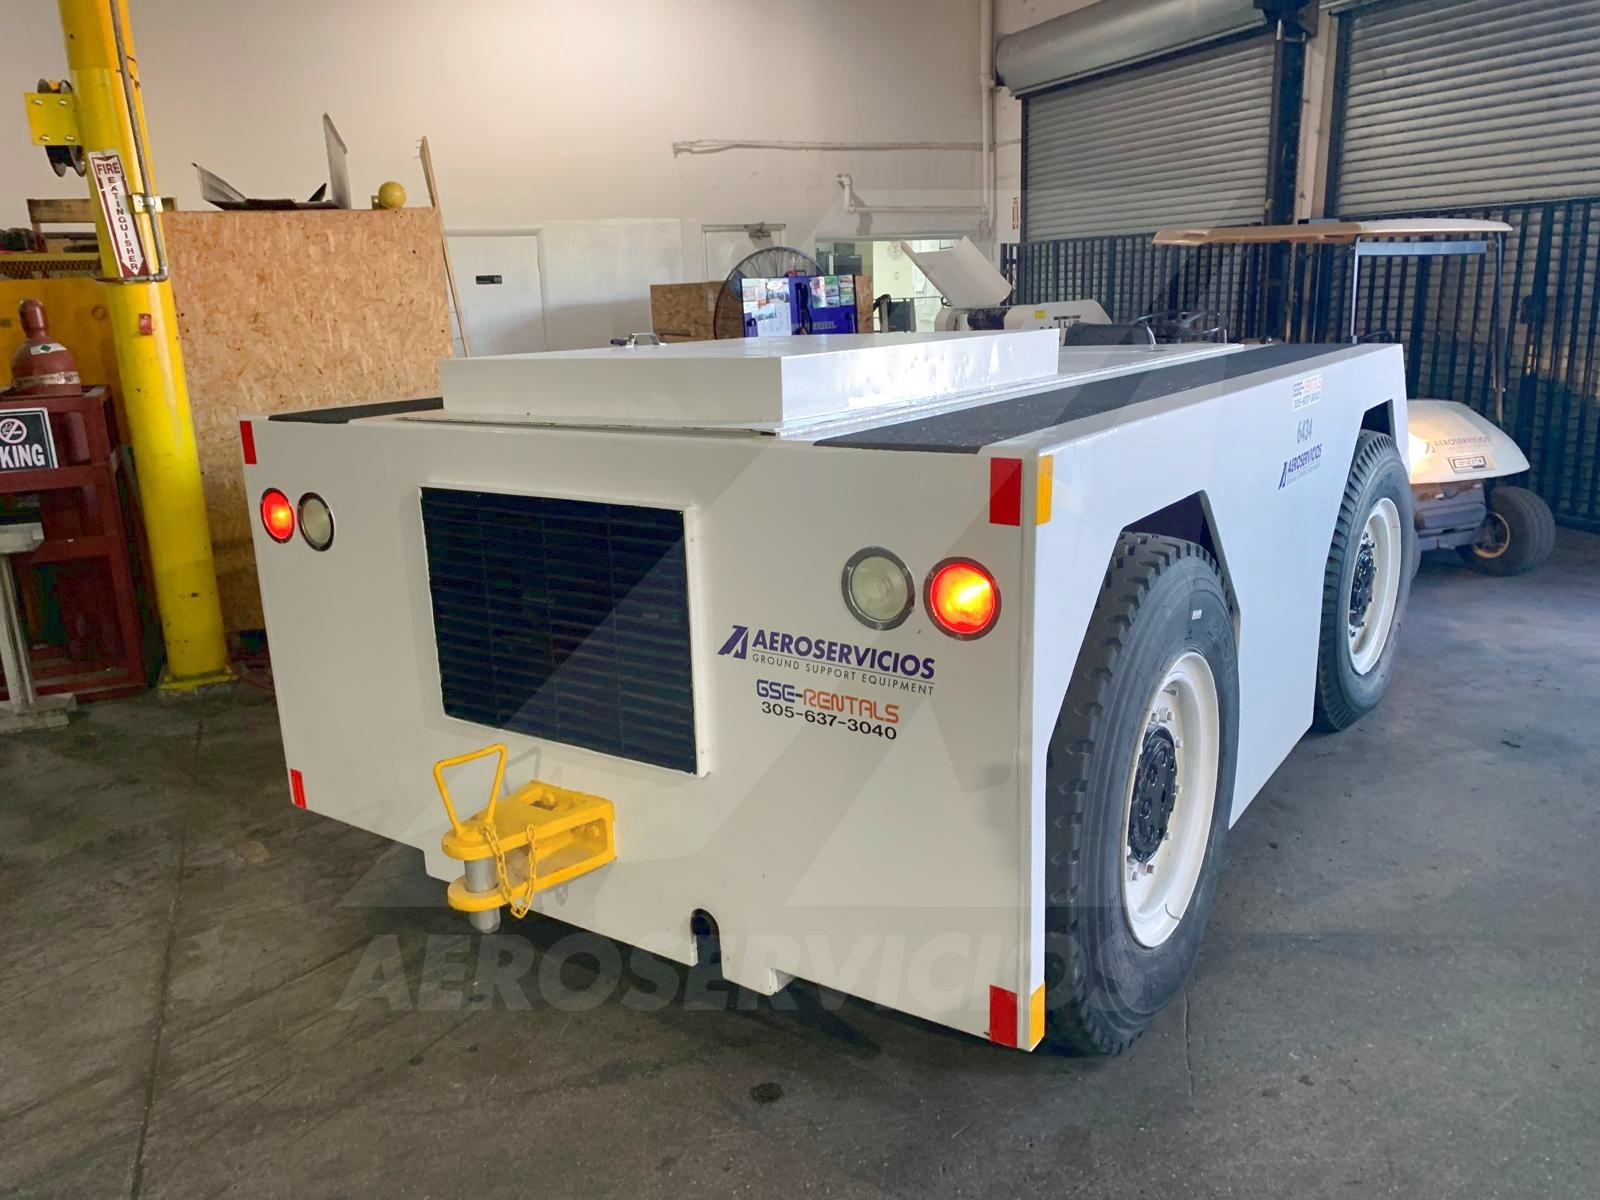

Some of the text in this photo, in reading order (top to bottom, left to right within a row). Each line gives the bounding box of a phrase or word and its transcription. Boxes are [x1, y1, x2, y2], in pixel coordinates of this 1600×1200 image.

[96, 162, 120, 175] FIRE
[107, 176, 138, 270] EXTINGUISHER
[1296, 417, 1312, 444] 6434
[1287, 443, 1322, 473] AEROSERVICIOS
[752, 629, 935, 680] AEROSERVICIOS
[752, 653, 934, 696] GROUND SUPPORT EQUIPMENT
[761, 701, 897, 740] 305-637-3040
